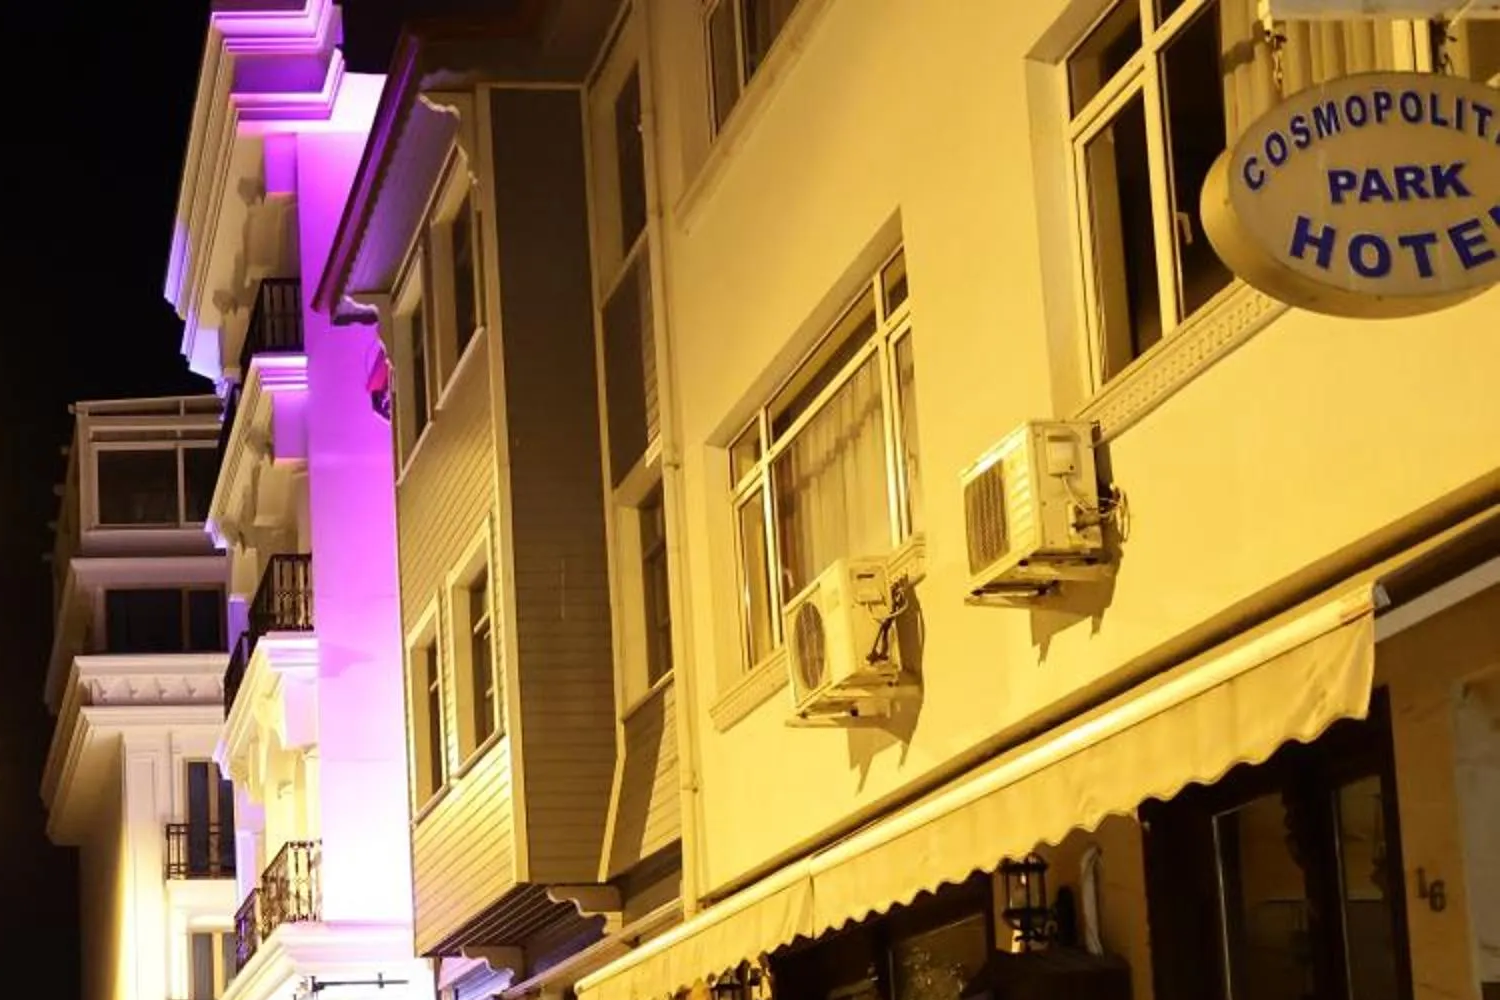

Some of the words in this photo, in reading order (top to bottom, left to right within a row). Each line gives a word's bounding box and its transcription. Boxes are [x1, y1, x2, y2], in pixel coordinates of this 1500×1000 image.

[1243, 91, 1500, 190] COSMOPOLIT
[1327, 162, 1472, 204] PARK
[1414, 866, 1447, 912] 16
